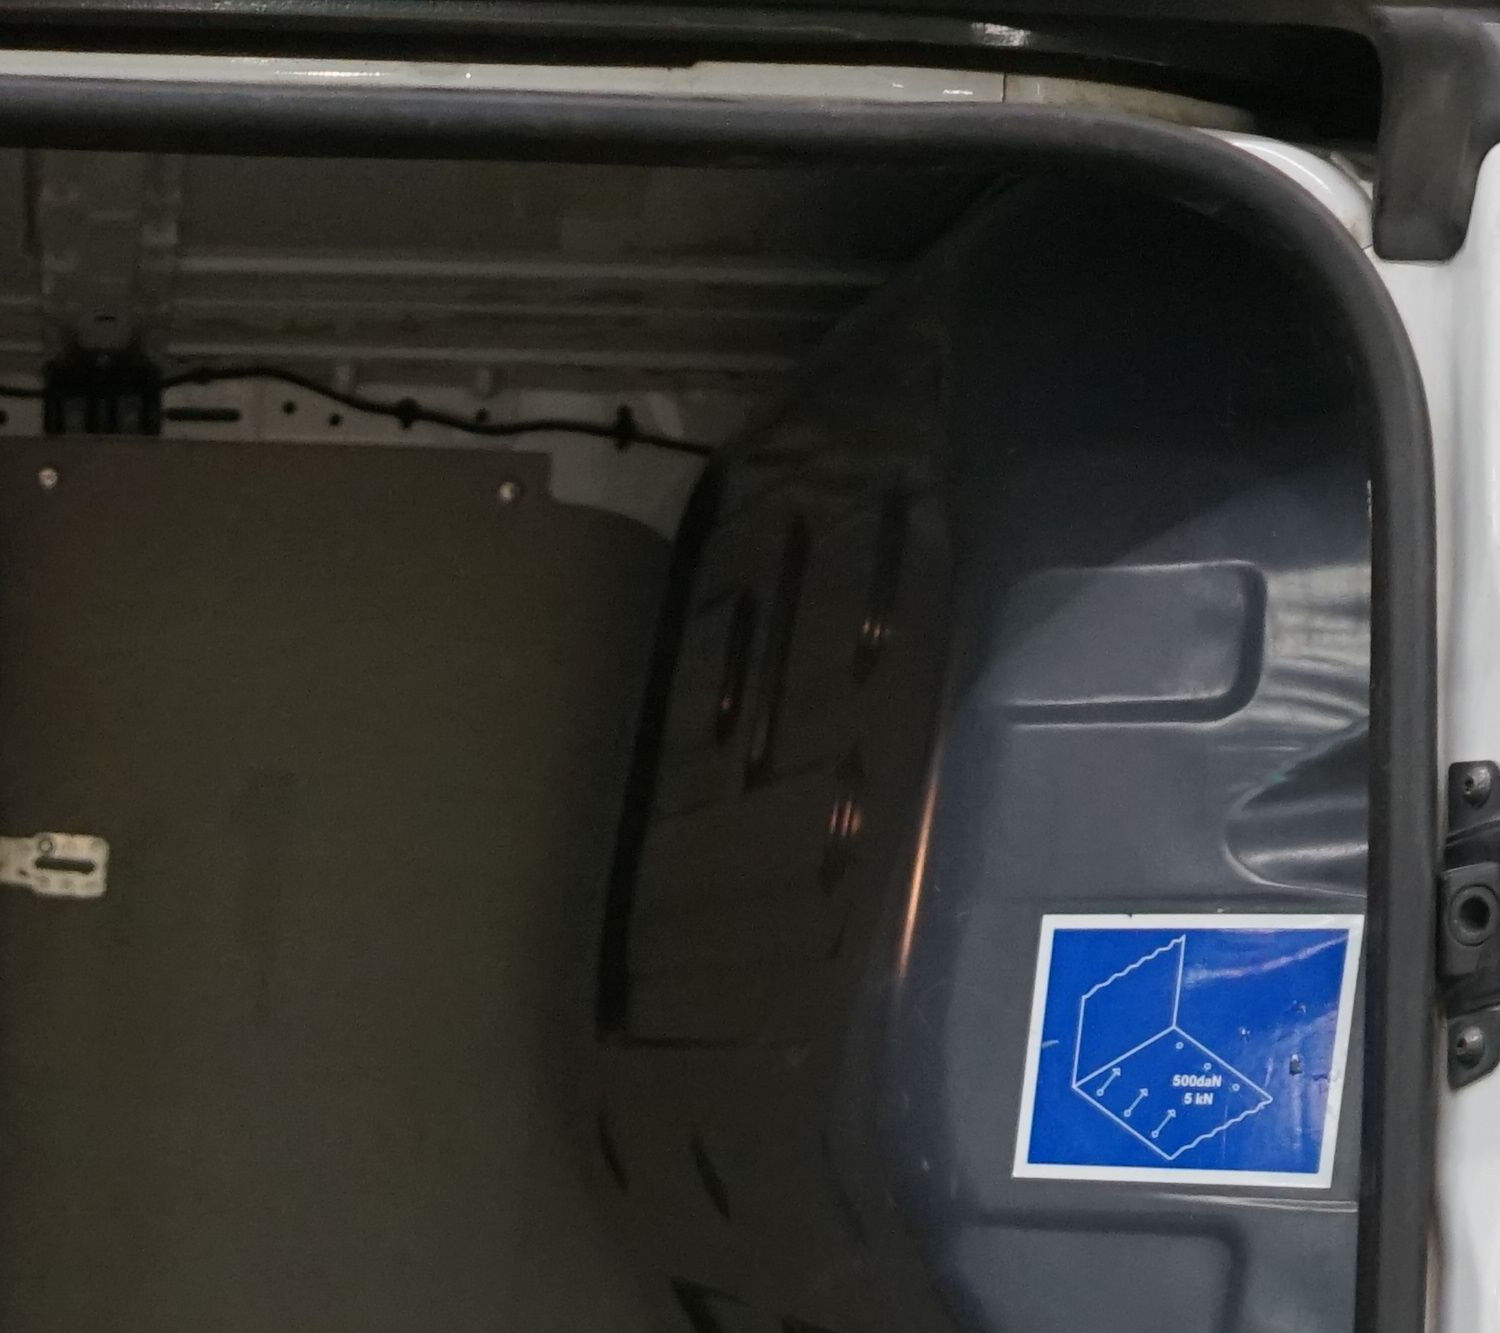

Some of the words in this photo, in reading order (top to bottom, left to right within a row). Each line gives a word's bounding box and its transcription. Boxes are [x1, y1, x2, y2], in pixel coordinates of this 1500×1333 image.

[1172, 1074, 1222, 1088] 500daN
[1183, 1092, 1193, 1105] 5
[1195, 1092, 1214, 1105] kN
